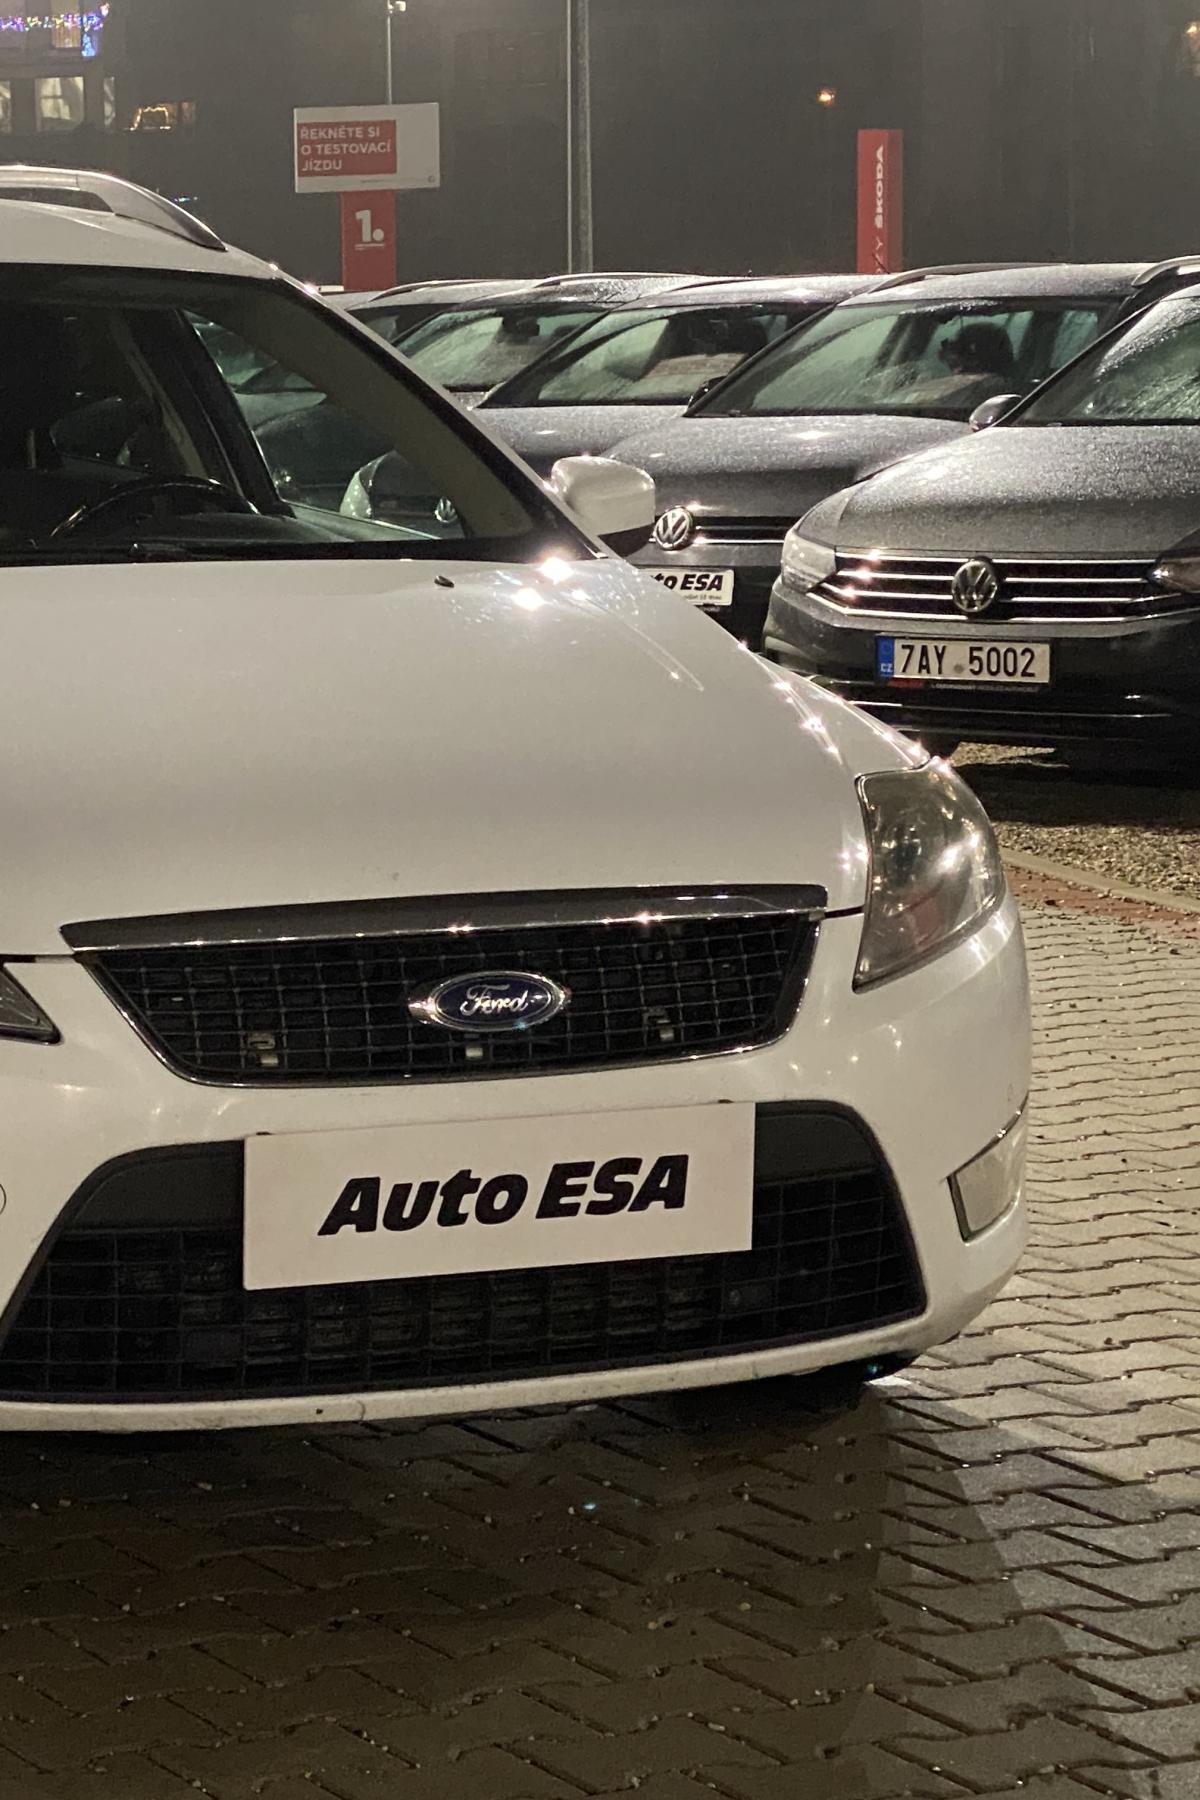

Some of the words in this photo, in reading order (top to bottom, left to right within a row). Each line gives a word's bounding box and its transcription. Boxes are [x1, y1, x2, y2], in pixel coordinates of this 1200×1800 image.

[300, 126, 363, 140] ŘEKNĚTE
[368, 126, 380, 138] SI
[301, 144, 312, 156] O
[316, 139, 391, 156] TESTOVACÍ
[302, 159, 343, 172] JÍZDU
[874, 143, 884, 229] ŠKODA
[355, 210, 384, 243] 1.
[680, 573, 723, 591] ESA
[880, 663, 893, 673] CZ
[901, 644, 947, 675] 7AY
[969, 646, 1036, 678] 5002
[460, 984, 529, 1016] Ford
[317, 1169, 528, 1236] Auto
[536, 1154, 689, 1220] ESA
